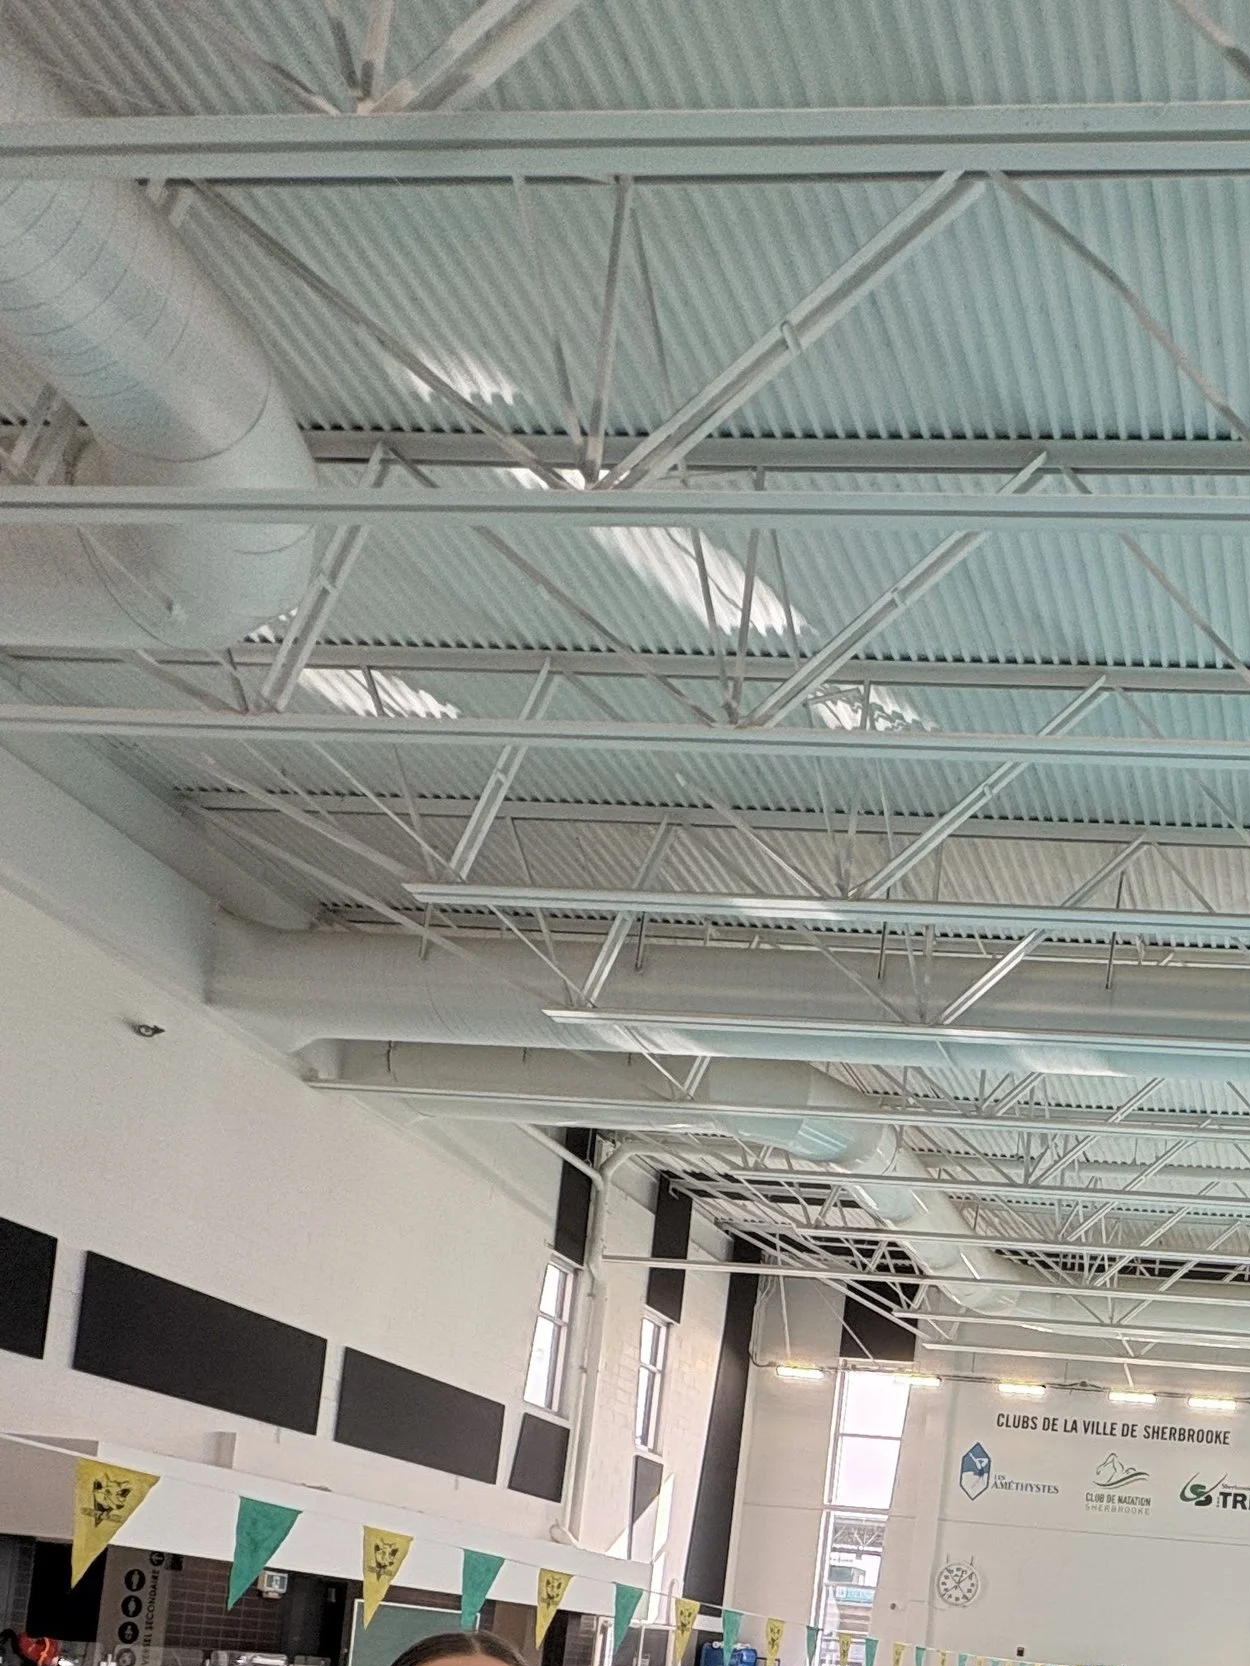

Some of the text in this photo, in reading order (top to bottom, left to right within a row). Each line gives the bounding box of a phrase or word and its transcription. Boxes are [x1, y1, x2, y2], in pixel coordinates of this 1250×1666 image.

[996, 1413, 1231, 1445] CLUBS DE LA VILLE DE SHERBROOKE
[991, 1480, 1060, 1494] AMÉTHYSTES
[1085, 1492, 1152, 1506] CLUB DE NATATION
[1085, 1503, 1151, 1515] SHERBROOKE
[144, 1569, 160, 1631] SECONDAIRE
